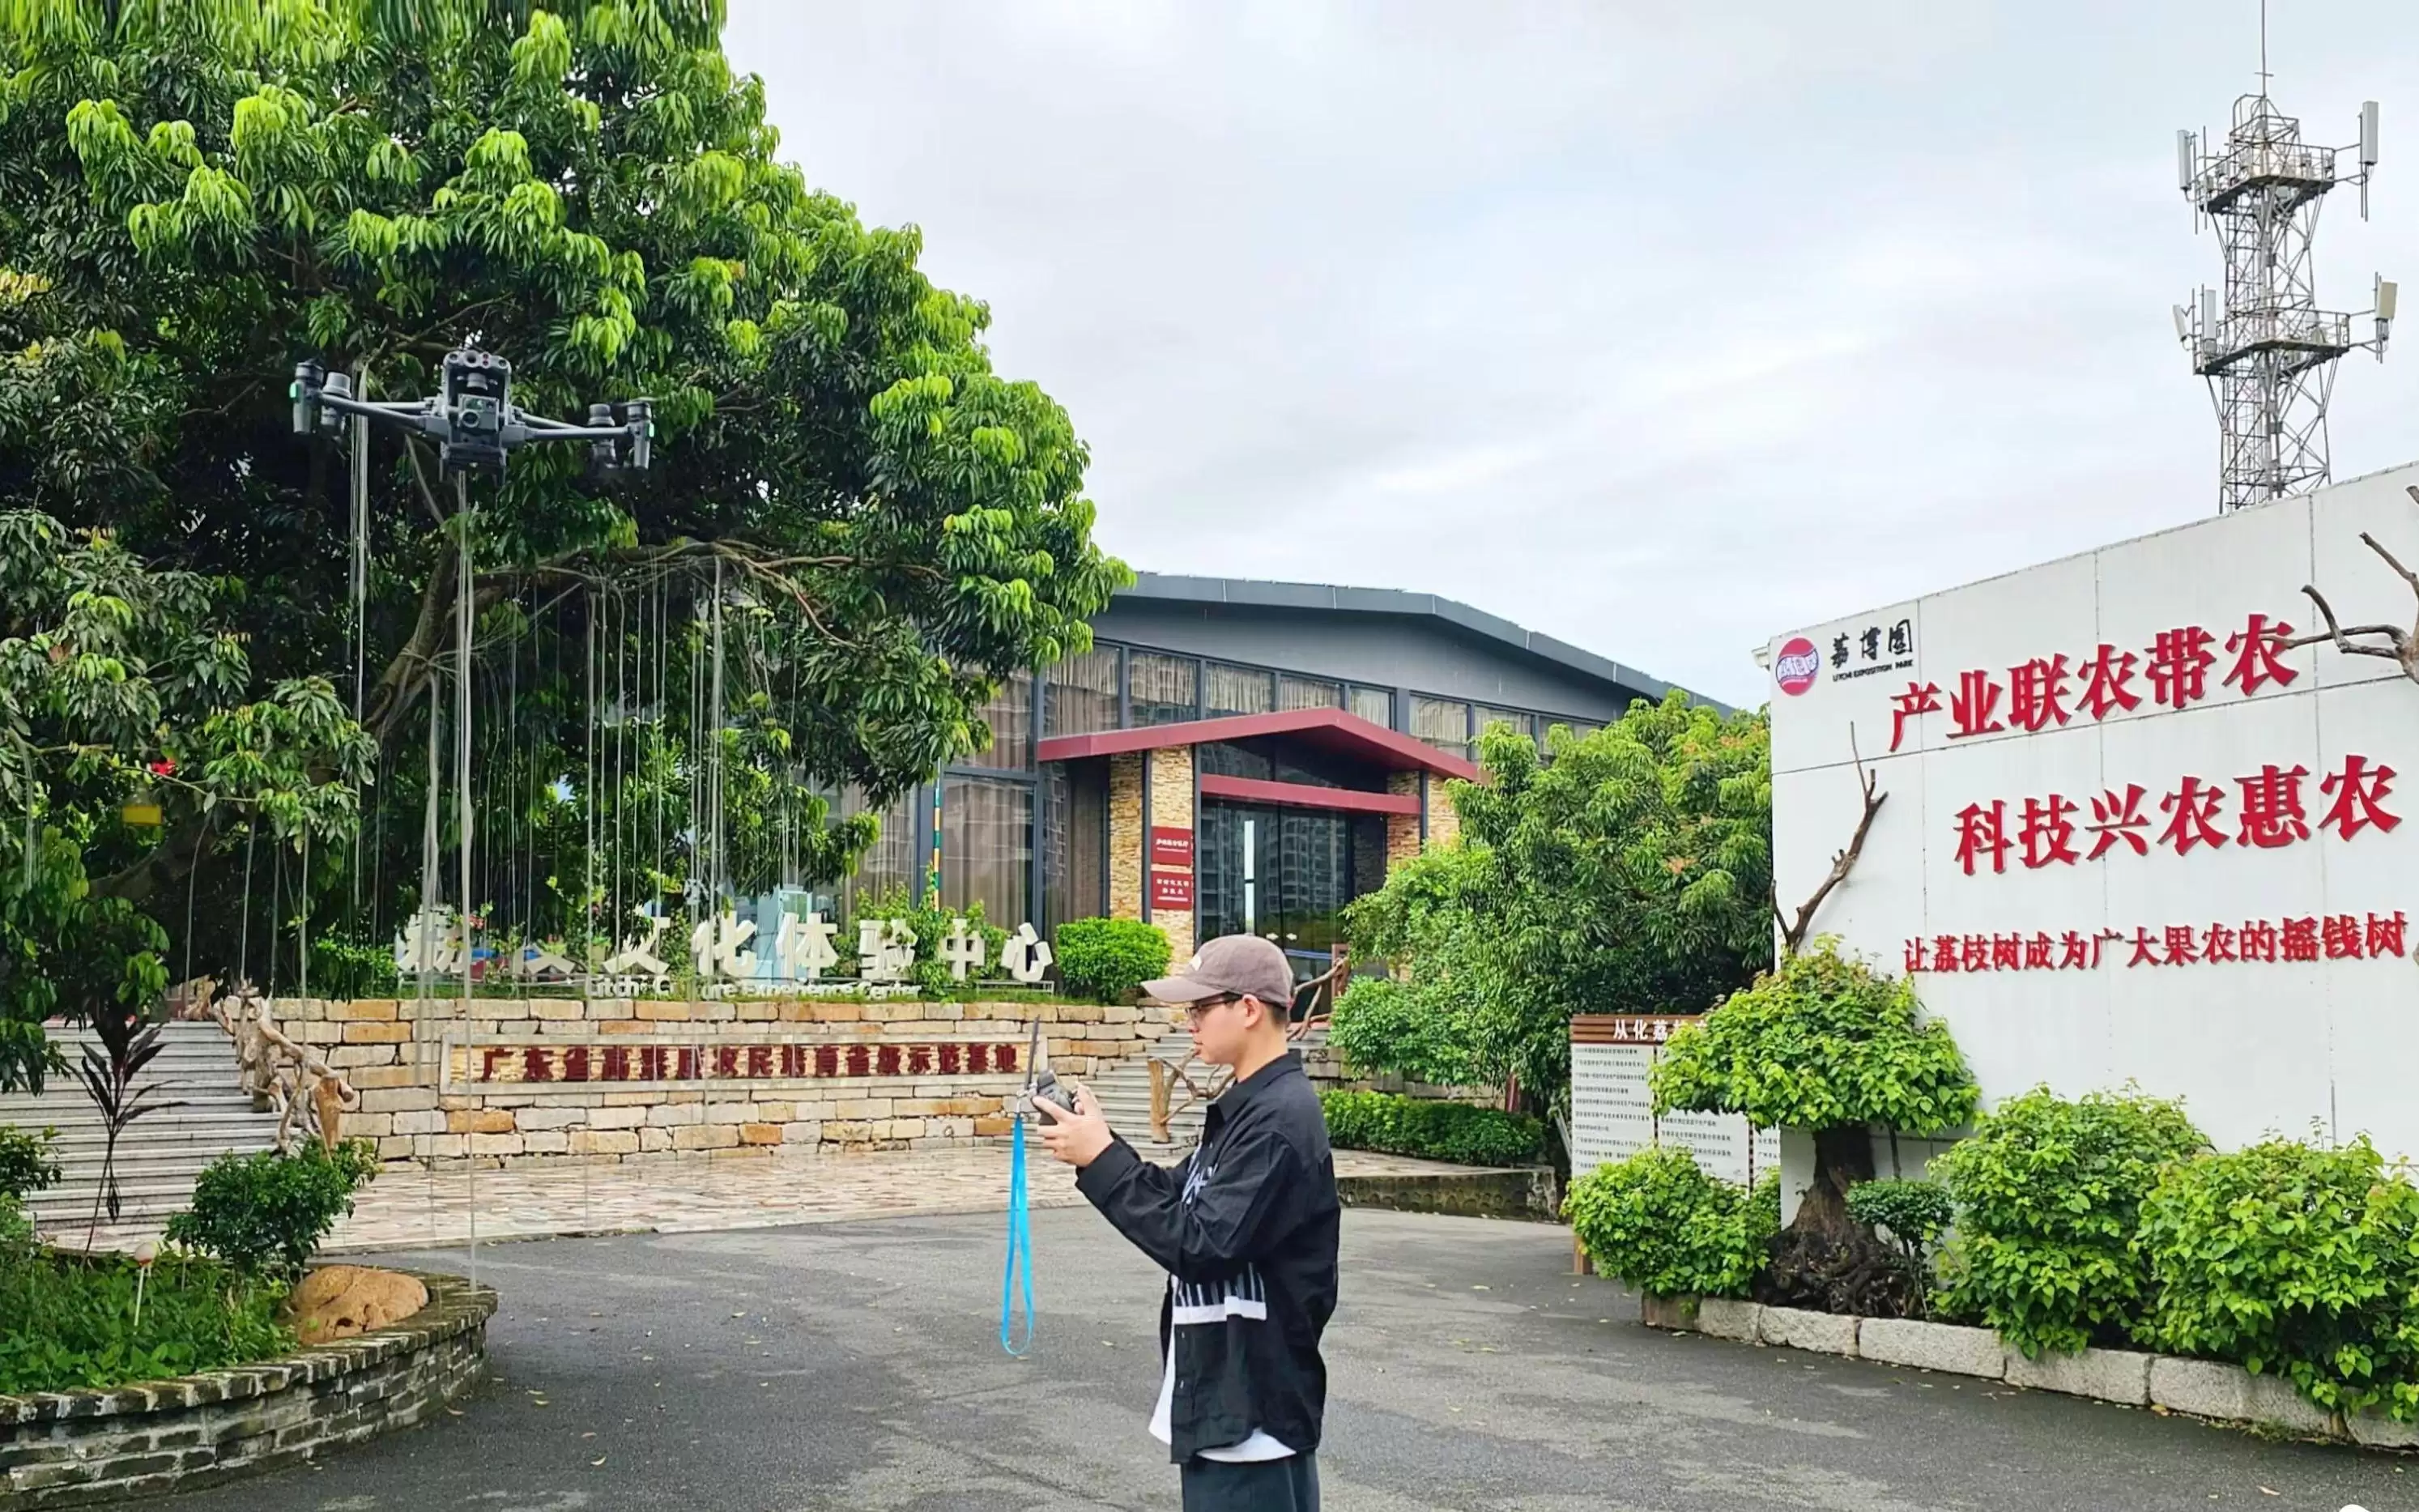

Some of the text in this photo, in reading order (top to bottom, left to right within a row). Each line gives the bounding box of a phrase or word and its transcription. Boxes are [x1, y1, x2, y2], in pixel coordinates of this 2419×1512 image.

[1889, 614, 2299, 752] 产业联农带农
[1895, 659, 1913, 670] PARK
[1953, 754, 2403, 876] 科技兴农惠农
[1902, 910, 2408, 972] 让荔枝树成为广大果农的摇钱树
